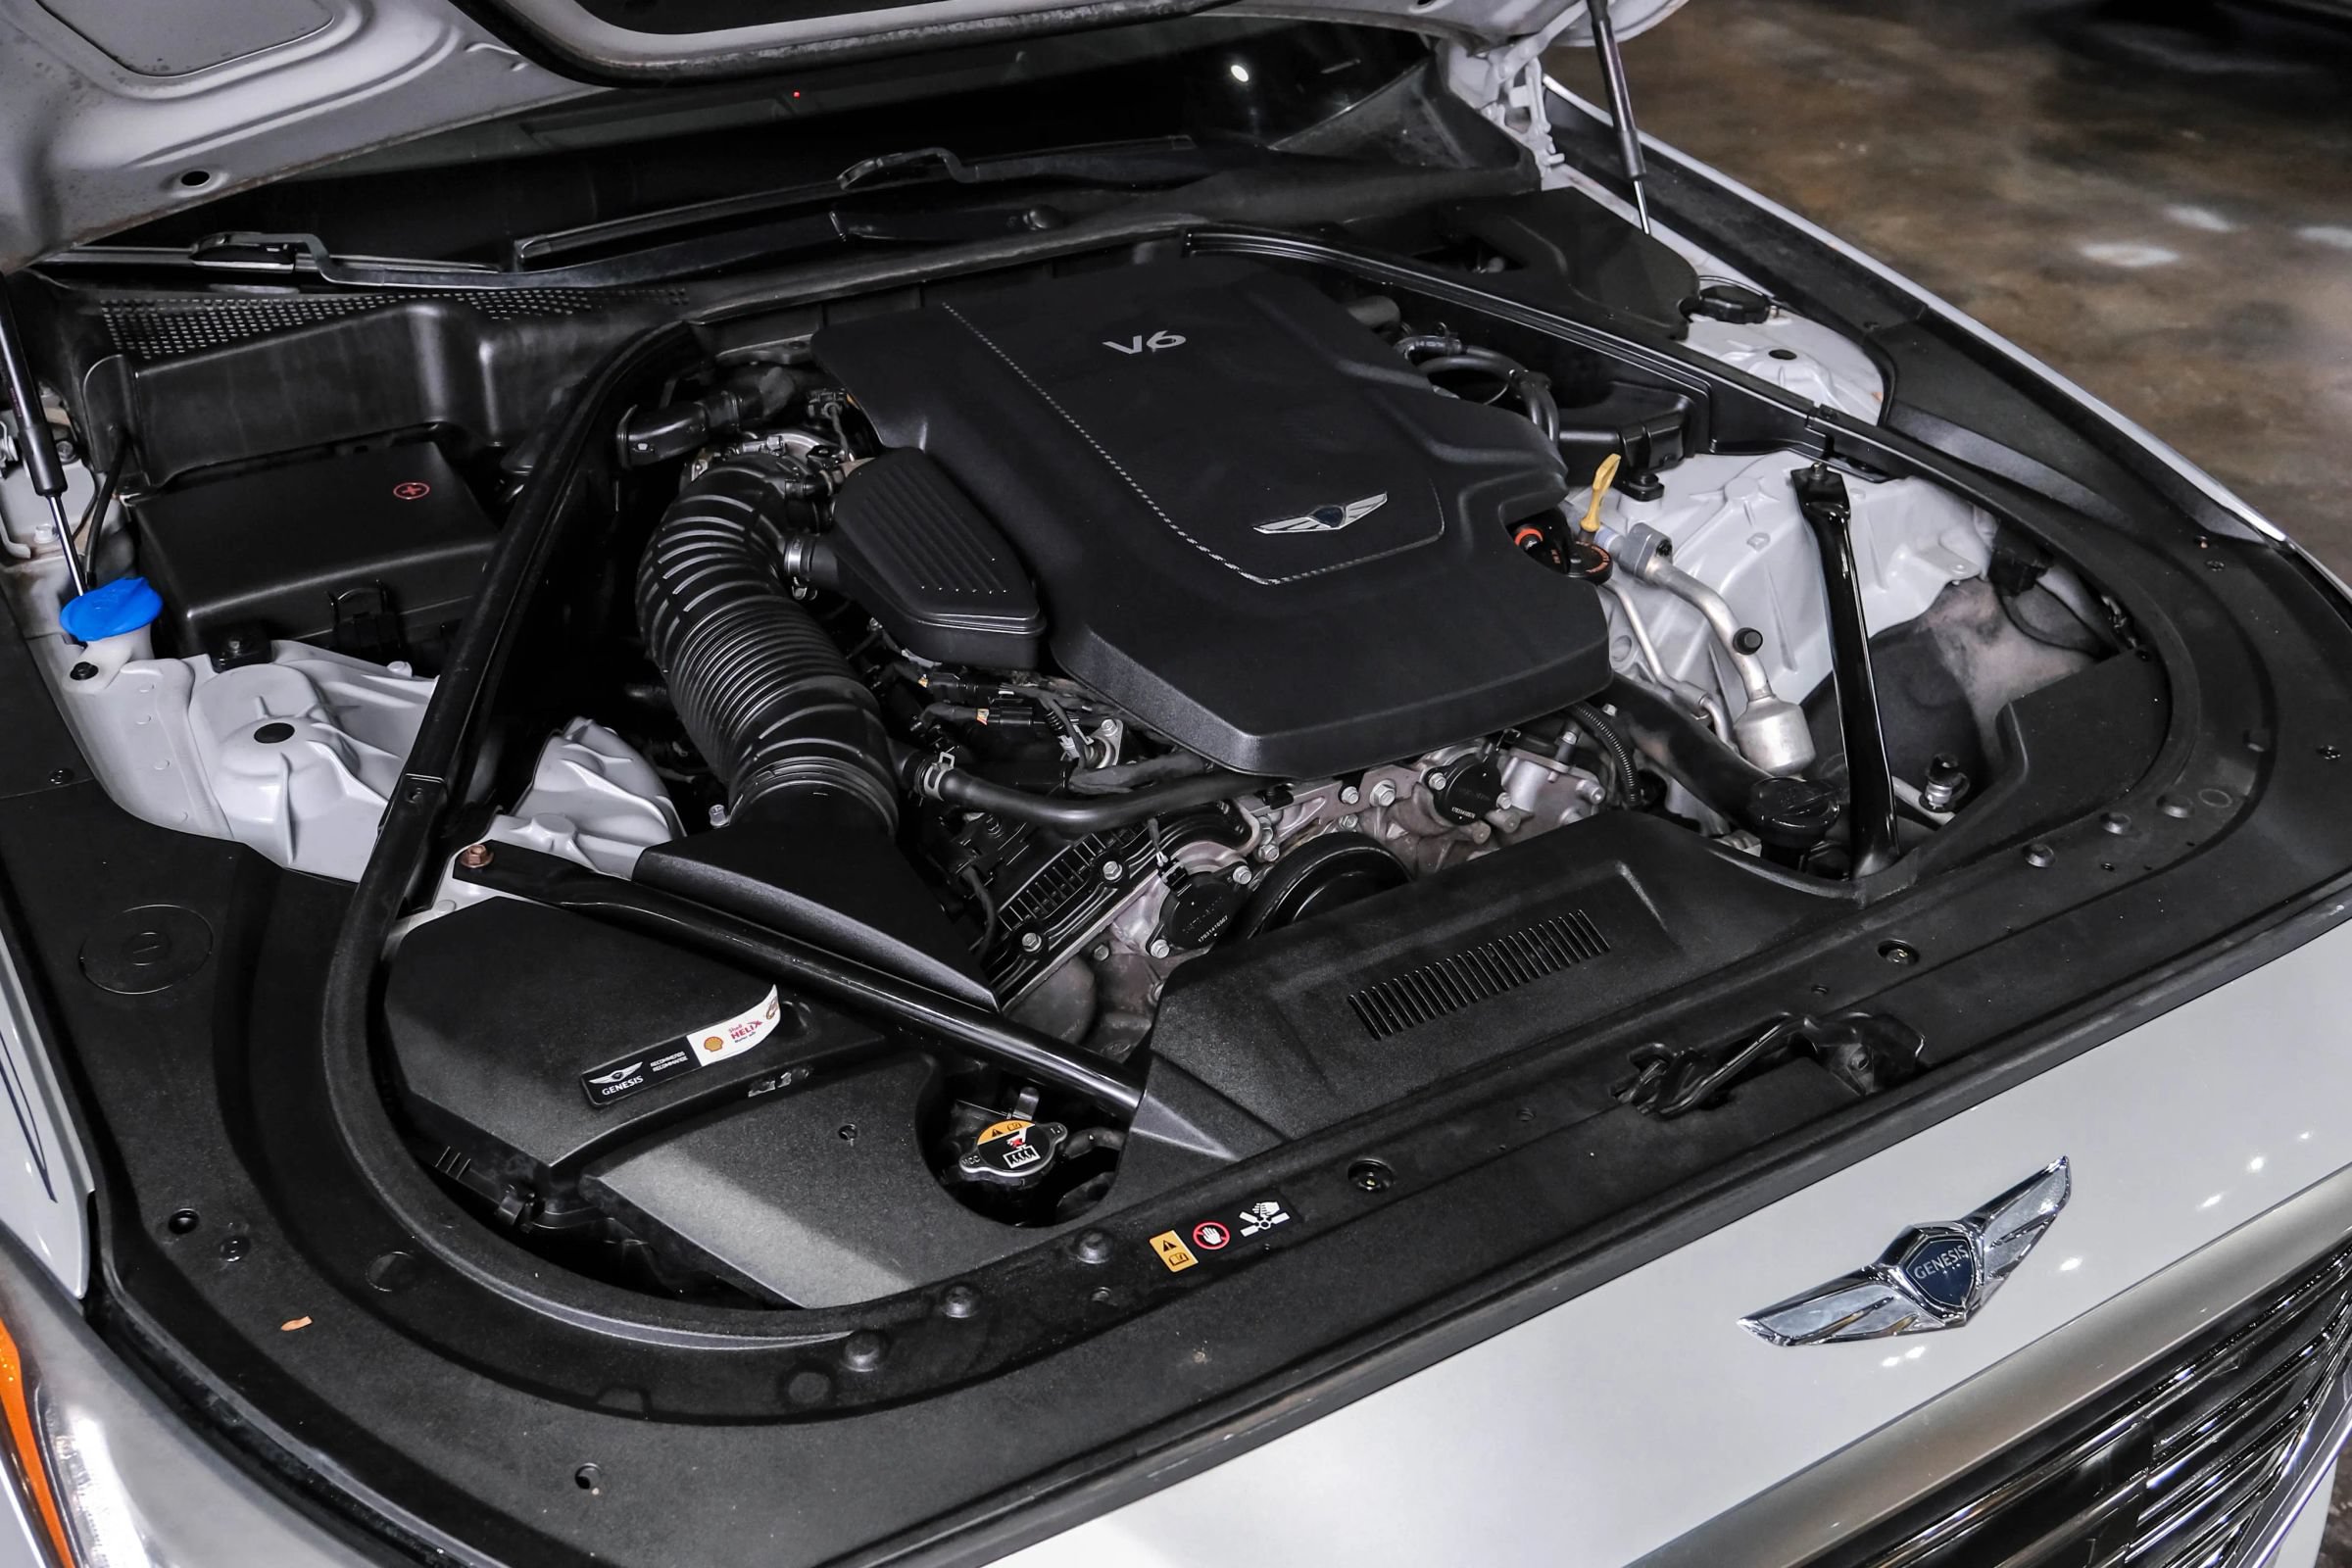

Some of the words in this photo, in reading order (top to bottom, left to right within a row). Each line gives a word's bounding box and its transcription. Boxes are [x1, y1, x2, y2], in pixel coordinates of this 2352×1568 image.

[1102, 330, 1187, 354] V6
[730, 1019, 763, 1040] HELIX
[601, 1075, 644, 1096] GENESIS
[1914, 1245, 1970, 1279] GENESIS
